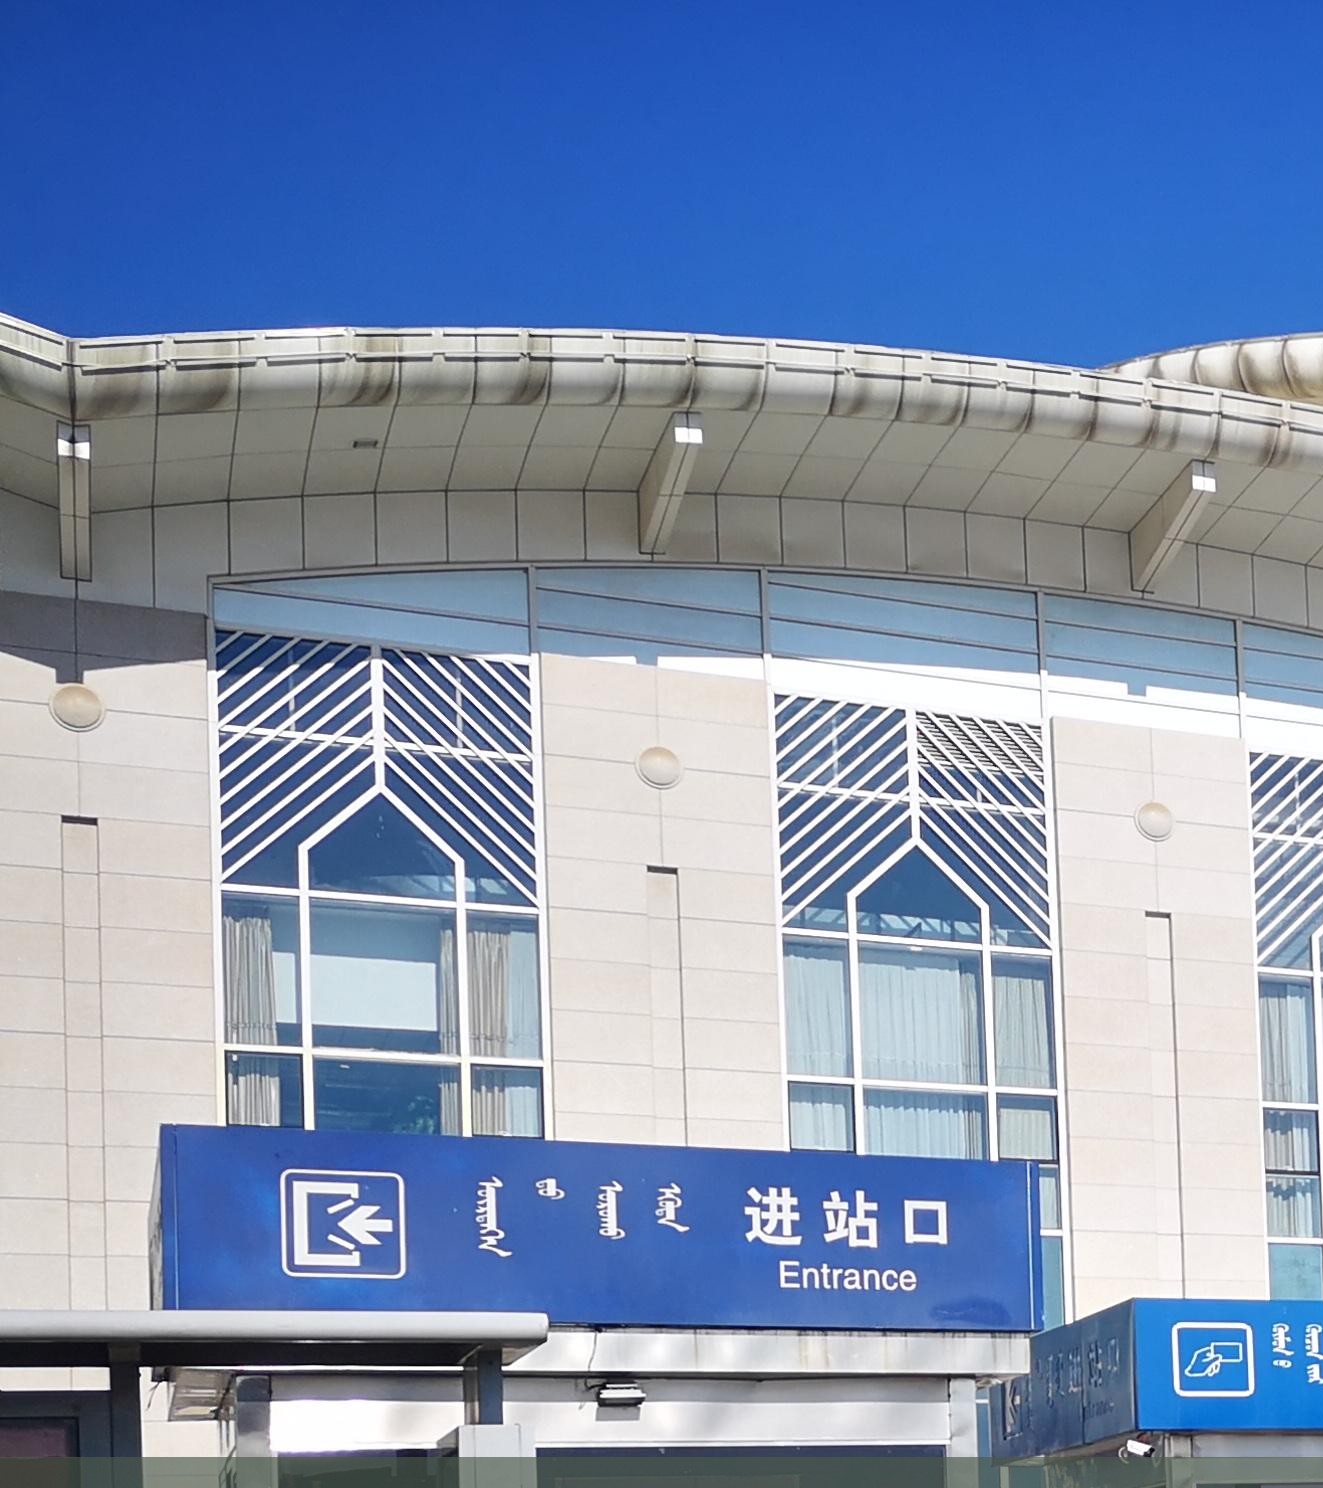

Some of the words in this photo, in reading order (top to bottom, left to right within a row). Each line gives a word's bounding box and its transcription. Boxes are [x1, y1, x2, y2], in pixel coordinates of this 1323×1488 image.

[744, 1186, 948, 1248] 进站口
[779, 1260, 918, 1291] Entrance
